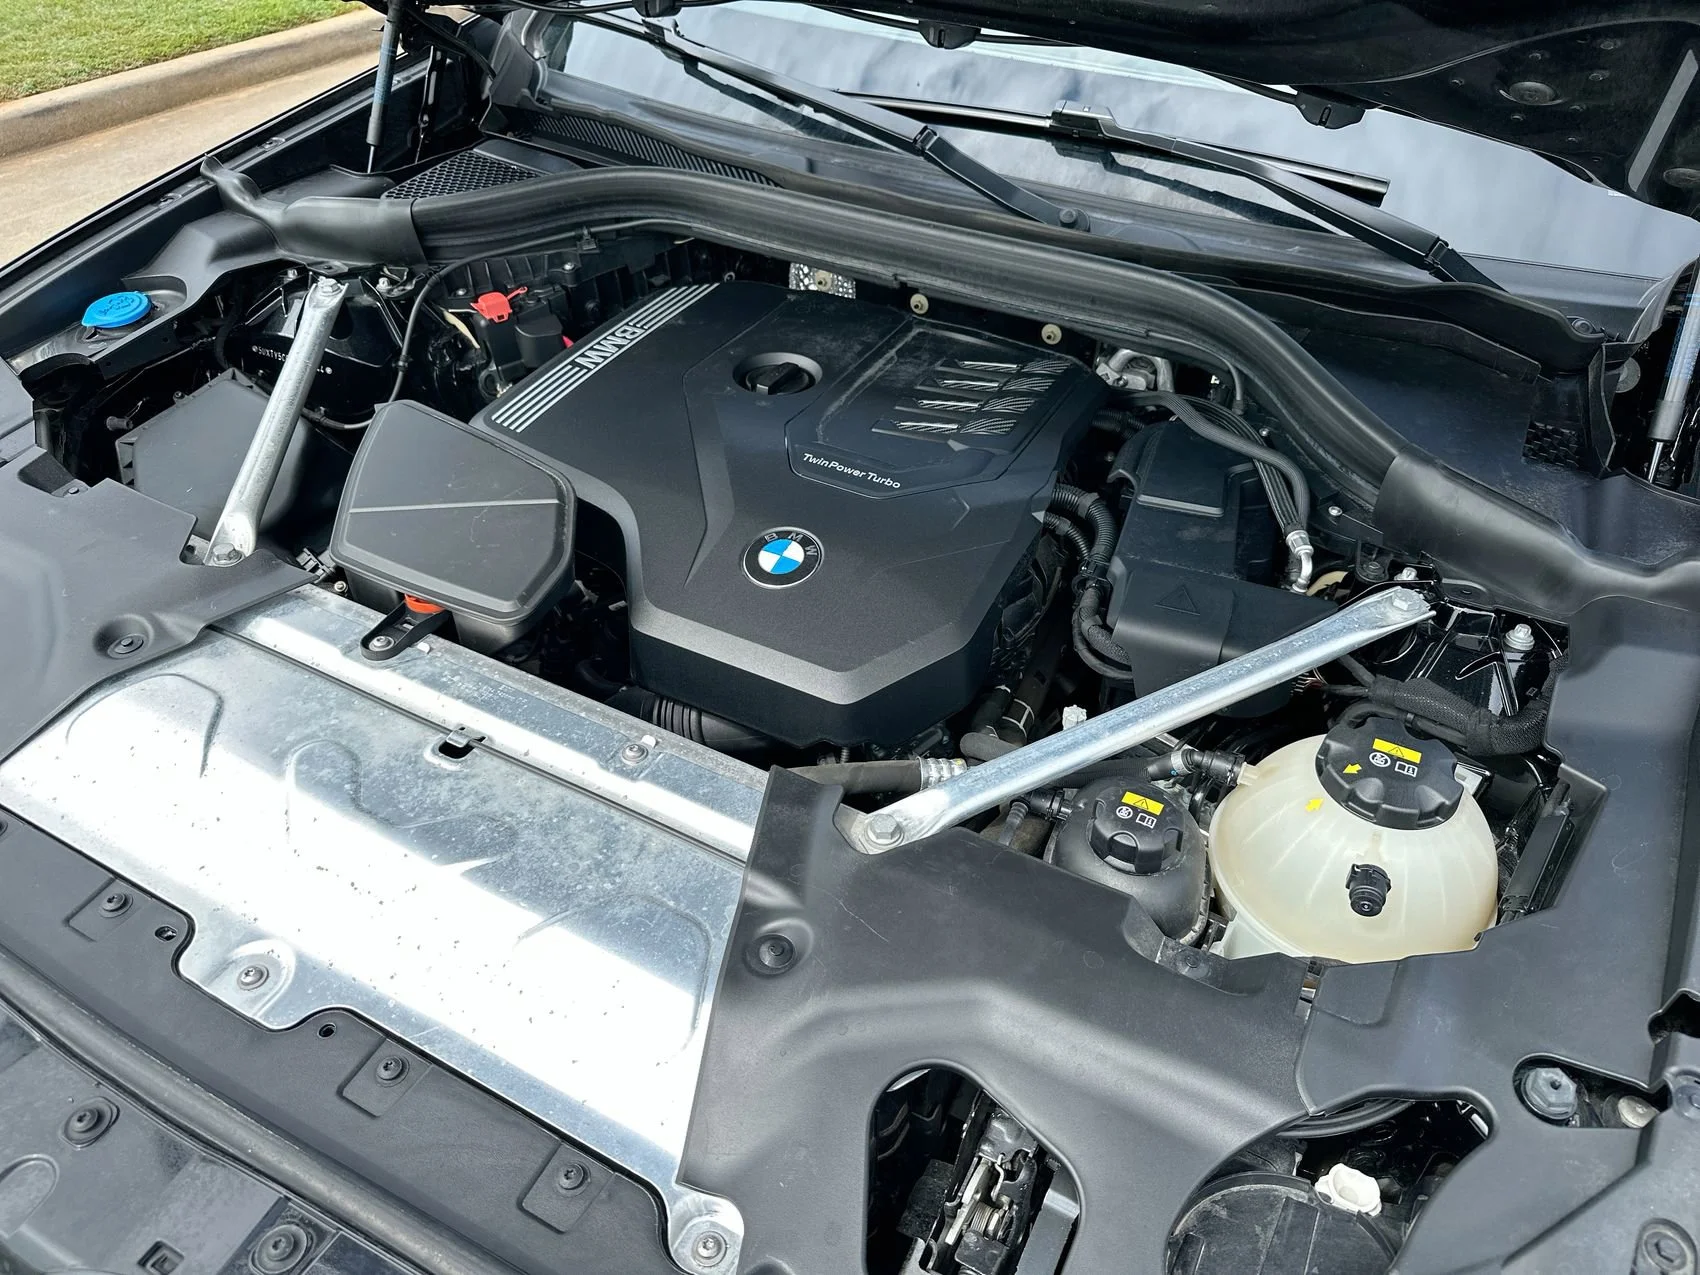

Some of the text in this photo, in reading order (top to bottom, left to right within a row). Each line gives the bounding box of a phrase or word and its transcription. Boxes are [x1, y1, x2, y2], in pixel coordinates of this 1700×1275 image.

[574, 325, 646, 369] BMW
[803, 453, 901, 489] TwinPower Turbo
[764, 532, 818, 556] BMW
